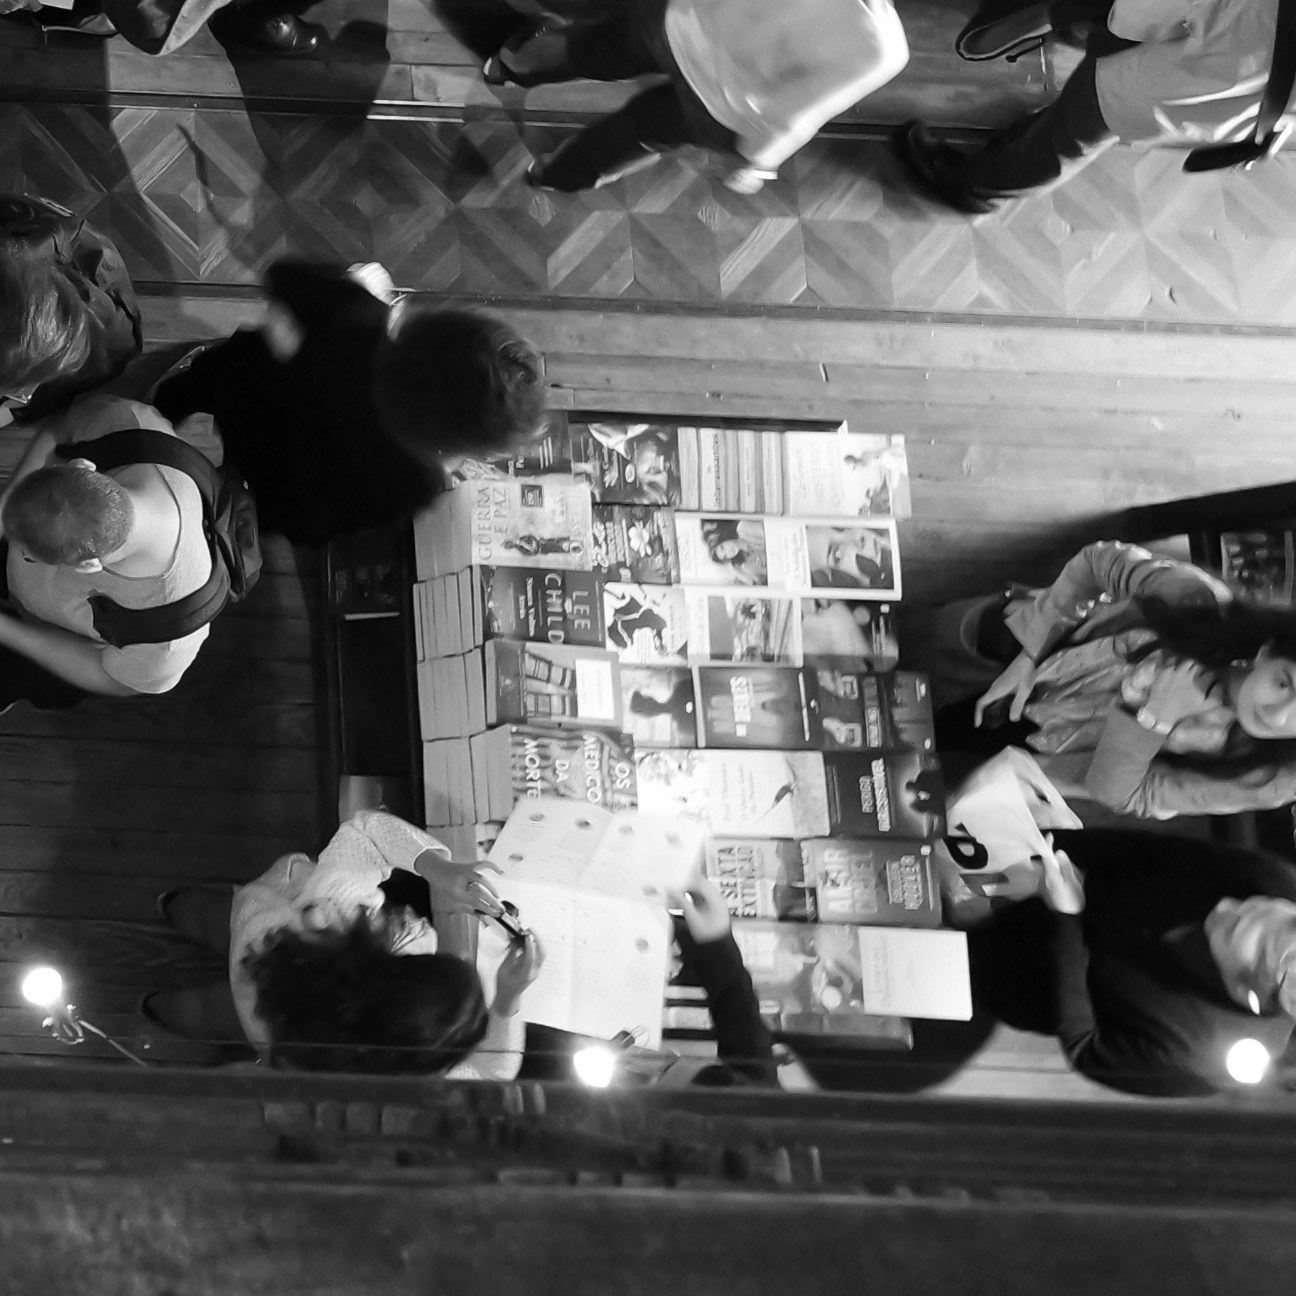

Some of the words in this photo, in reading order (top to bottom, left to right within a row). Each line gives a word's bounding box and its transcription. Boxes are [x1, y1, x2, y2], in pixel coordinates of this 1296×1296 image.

[476, 486, 493, 562] GUERRA
[491, 487, 508, 519] PAZ
[493, 522, 508, 536] E
[544, 572, 566, 644] CHILD
[572, 589, 591, 631] LEE
[523, 737, 544, 800] MORTE
[554, 758, 570, 783] DA
[581, 732, 604, 805] MEDICO
[614, 759, 631, 791] OS
